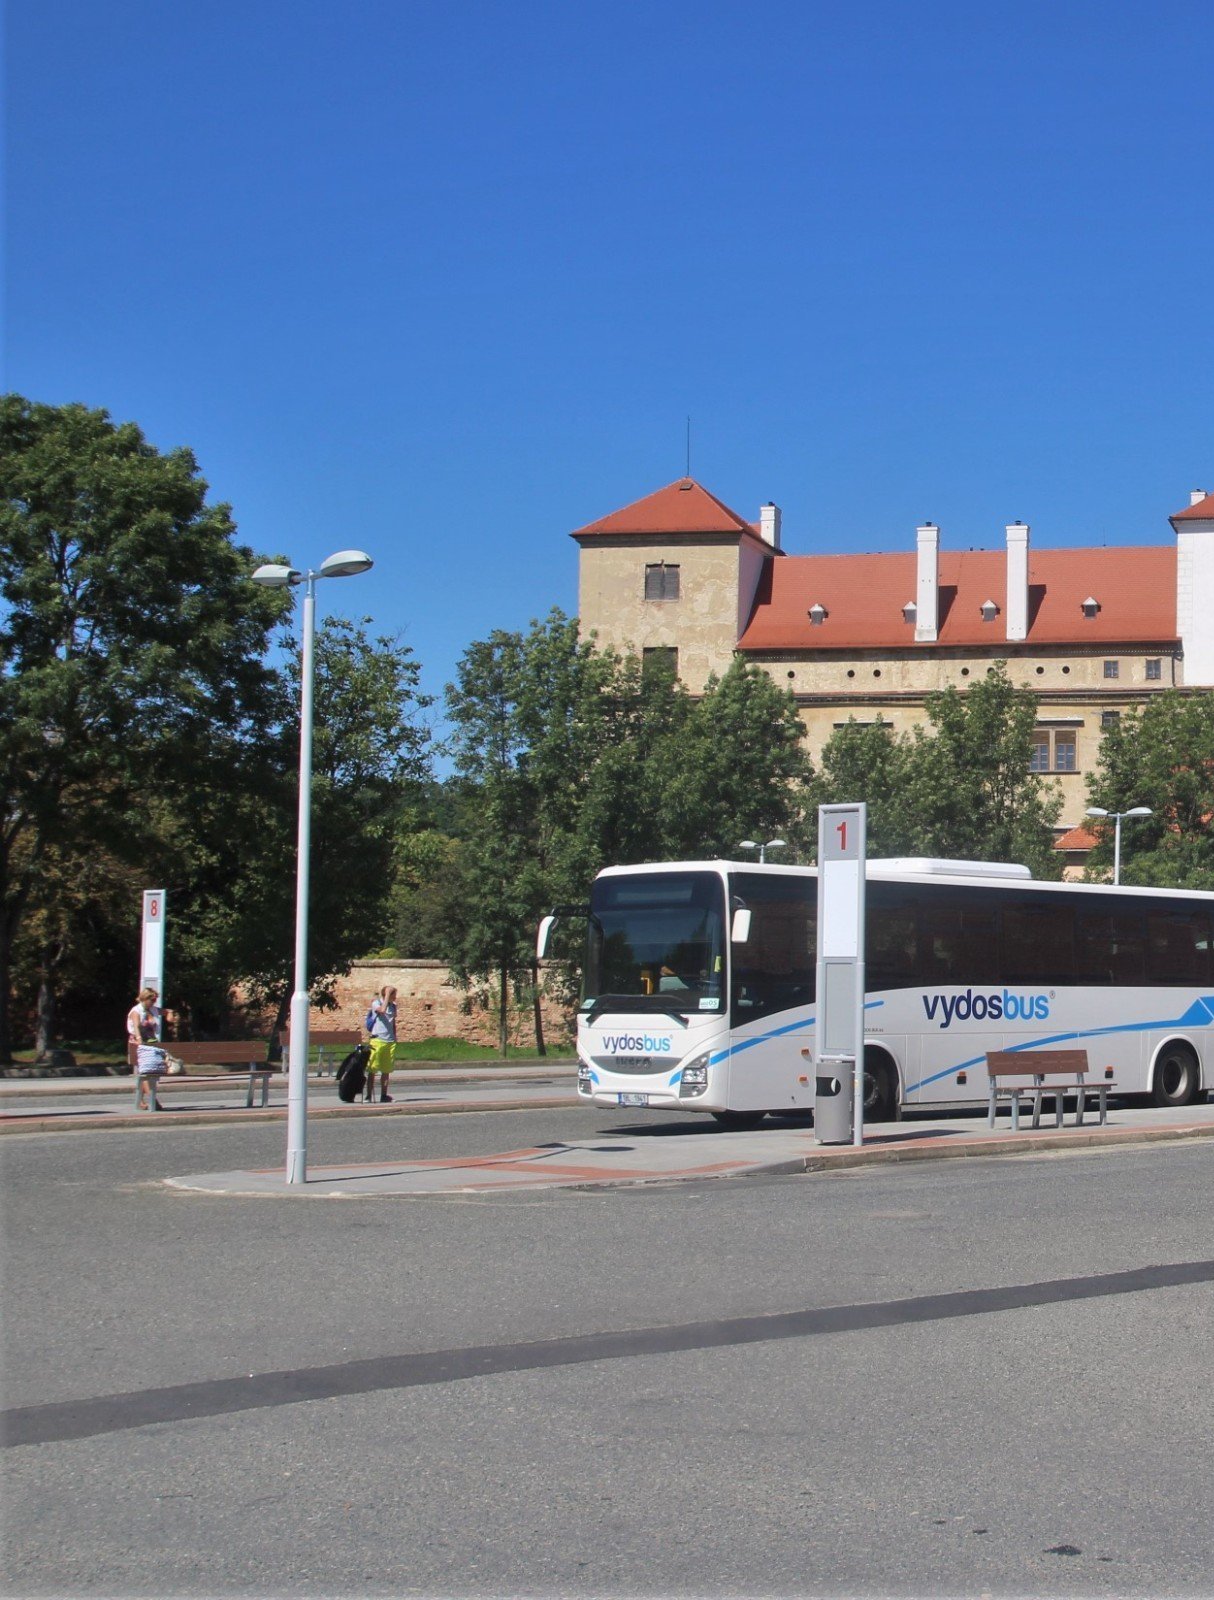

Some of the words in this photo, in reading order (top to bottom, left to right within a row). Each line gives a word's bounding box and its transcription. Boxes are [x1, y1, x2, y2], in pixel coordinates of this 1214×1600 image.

[836, 821, 847, 851] 1
[151, 900, 157, 917] 8
[602, 1033, 671, 1054] vydosbus
